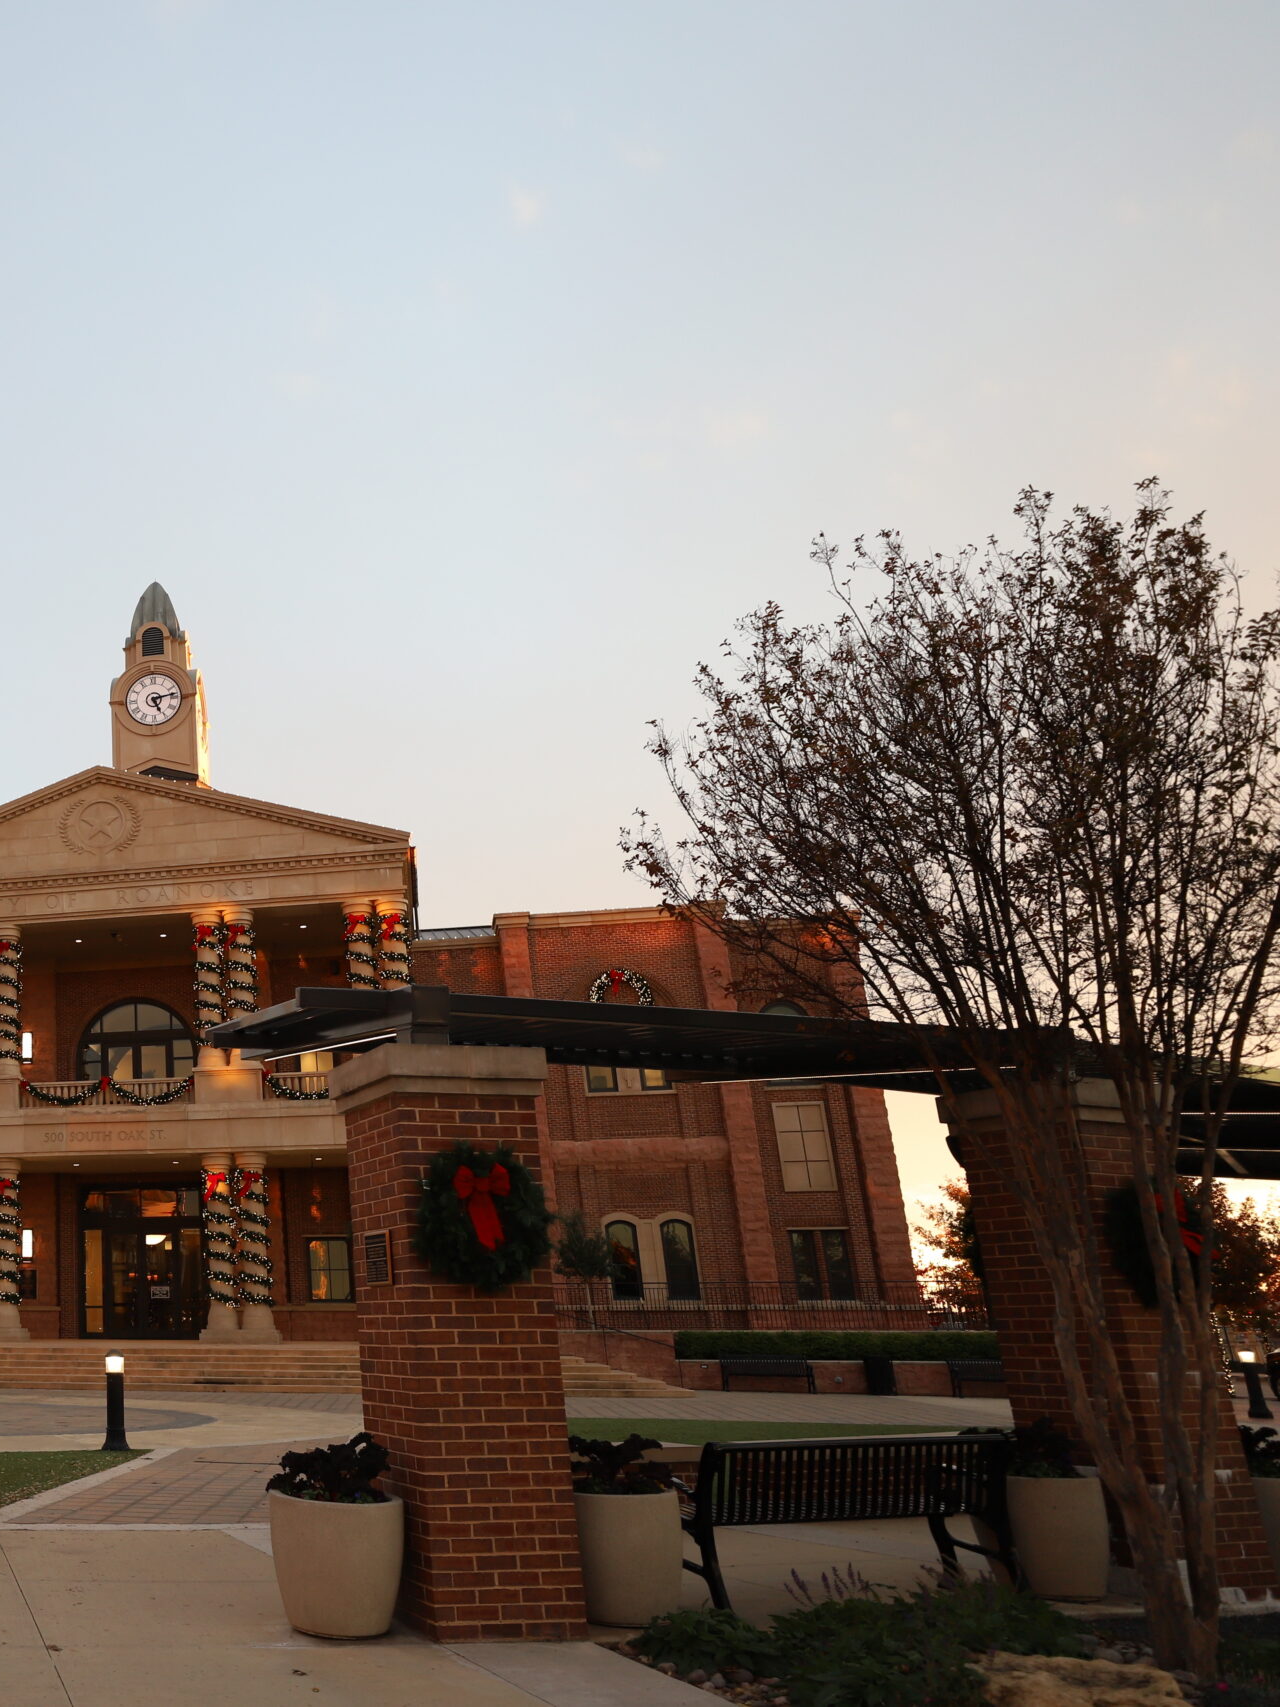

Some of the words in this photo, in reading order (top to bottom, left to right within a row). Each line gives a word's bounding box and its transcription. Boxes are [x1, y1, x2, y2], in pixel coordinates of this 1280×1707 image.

[45, 893, 77, 909] OF
[116, 880, 255, 905] ROANOKE
[43, 1132, 64, 1143] 500
[69, 1130, 113, 1143] SOUTH
[118, 1129, 145, 1141] OAK
